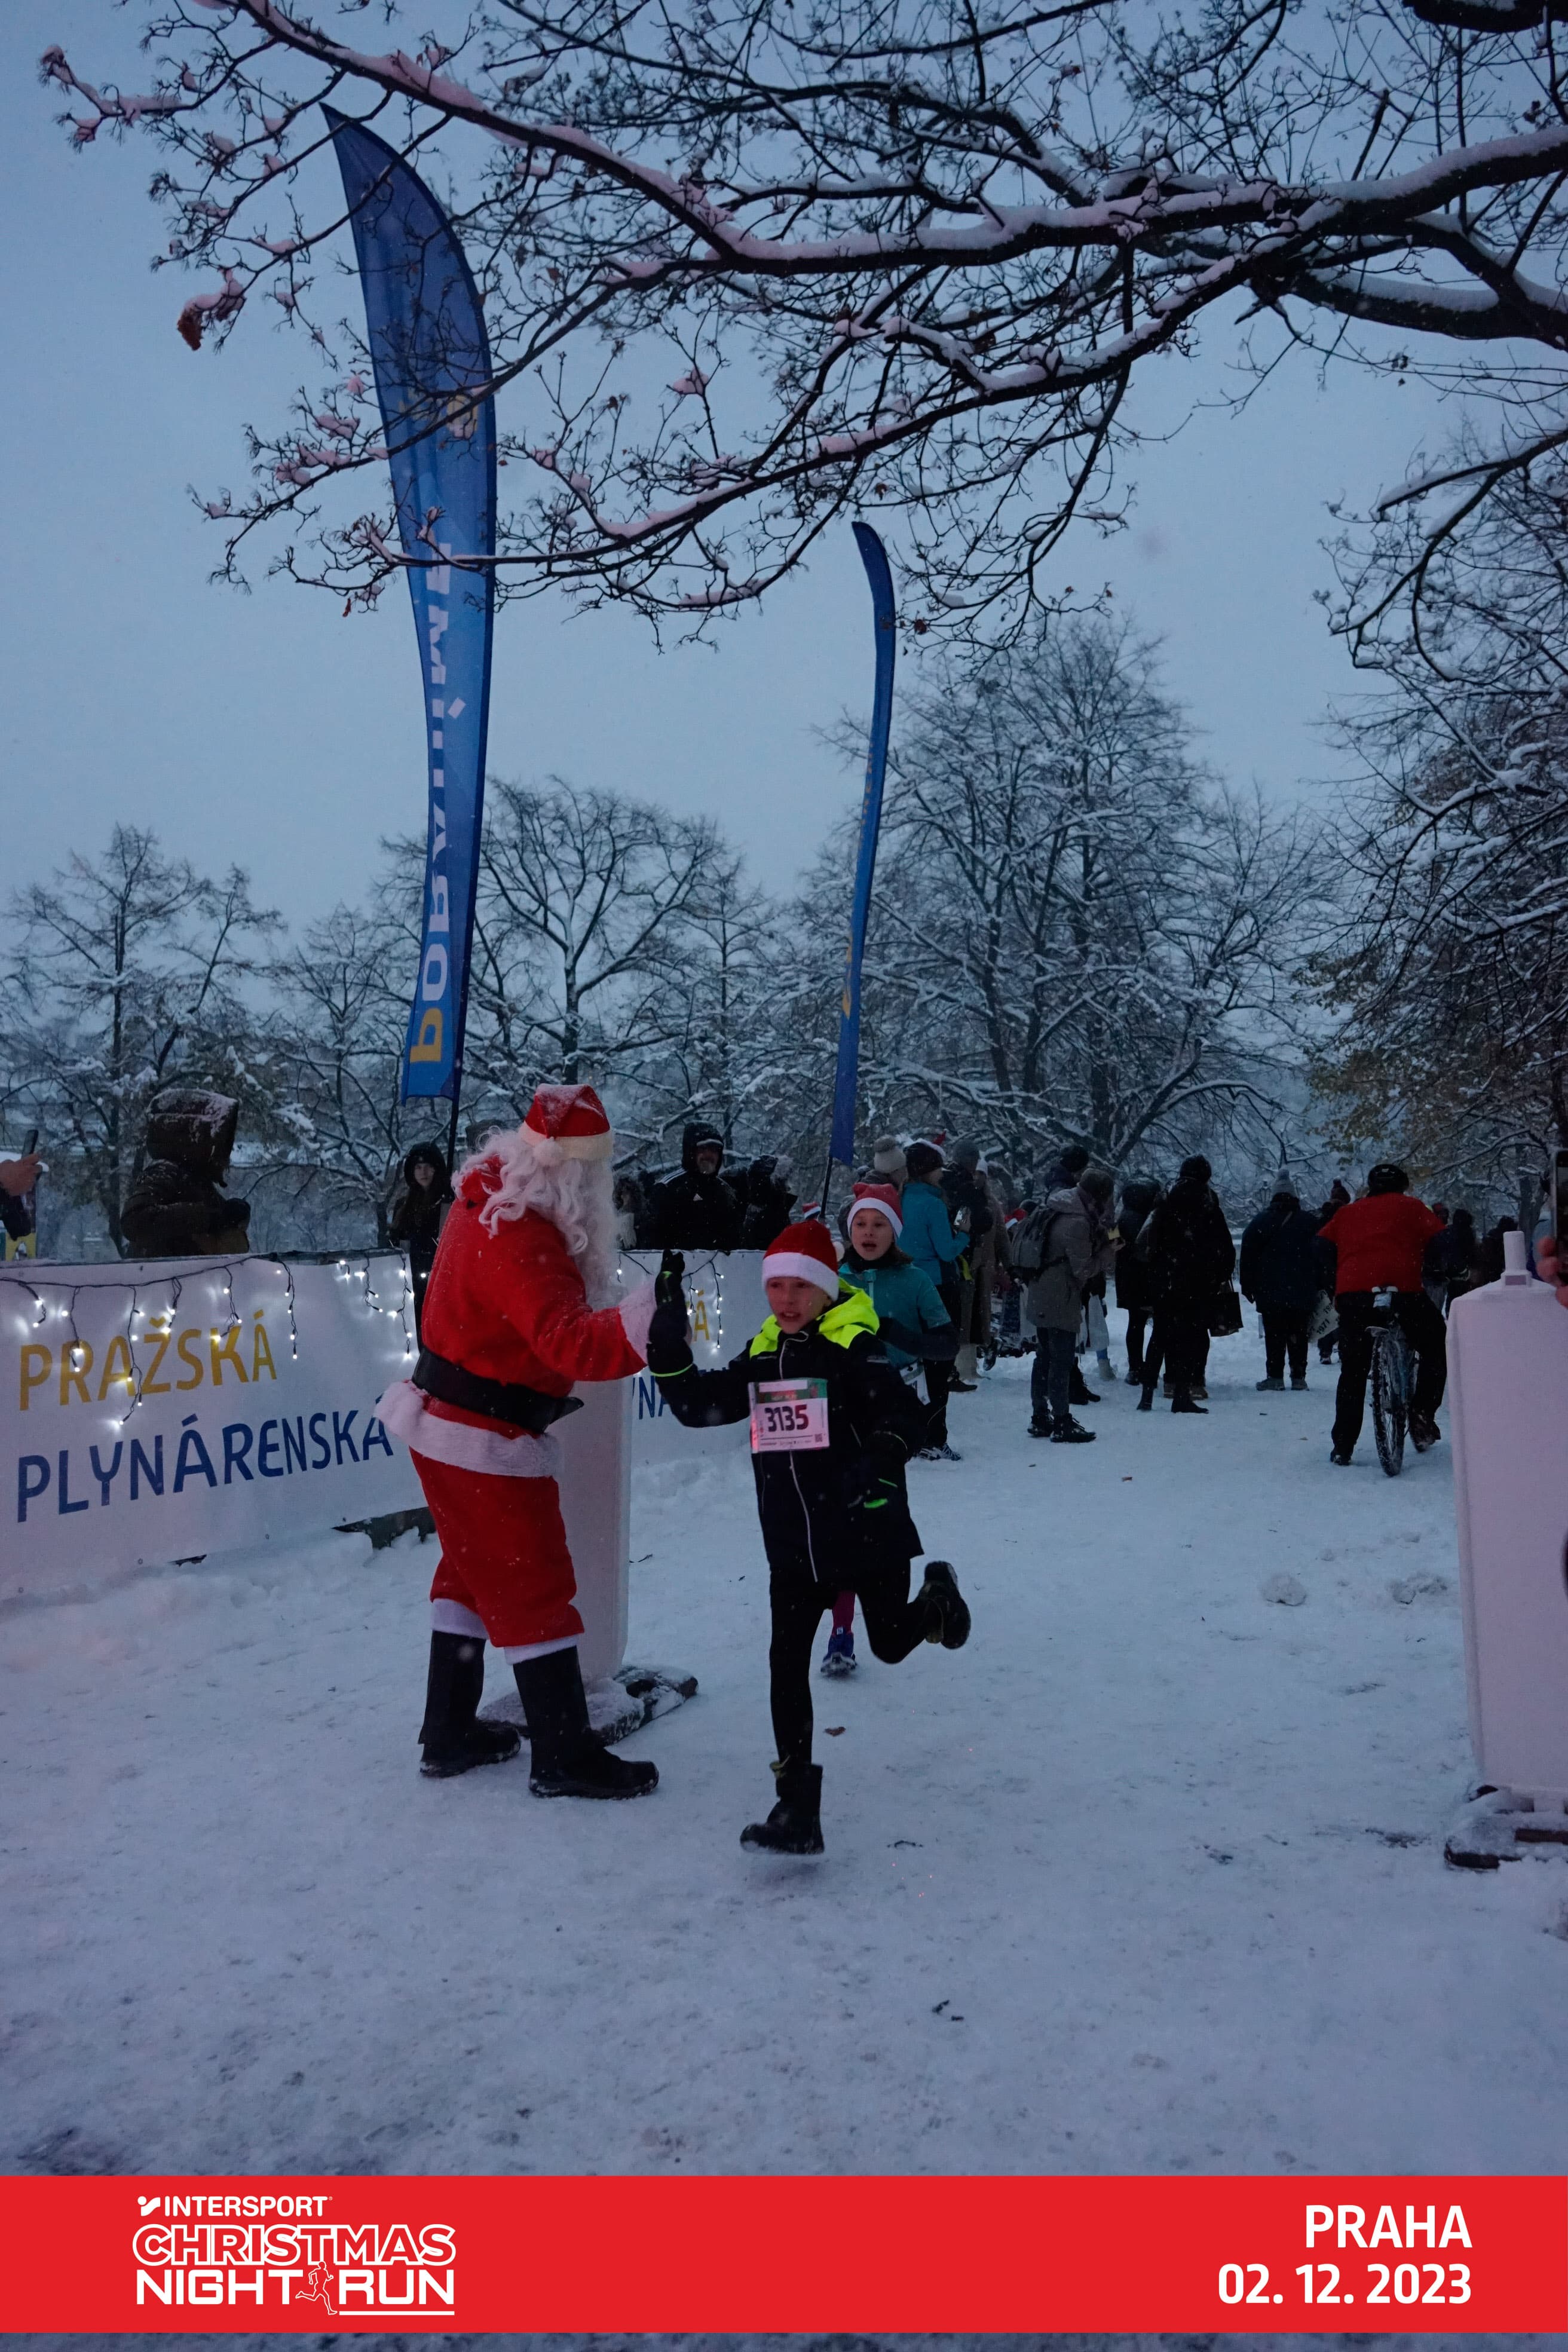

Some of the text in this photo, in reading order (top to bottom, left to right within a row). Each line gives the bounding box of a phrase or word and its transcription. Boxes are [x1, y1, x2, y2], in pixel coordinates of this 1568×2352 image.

[19, 1309, 277, 1411] PRAŽSKÁ
[17, 1393, 394, 1523] PLYNÁRENSKÁ
[764, 1404, 810, 1432] 3135
